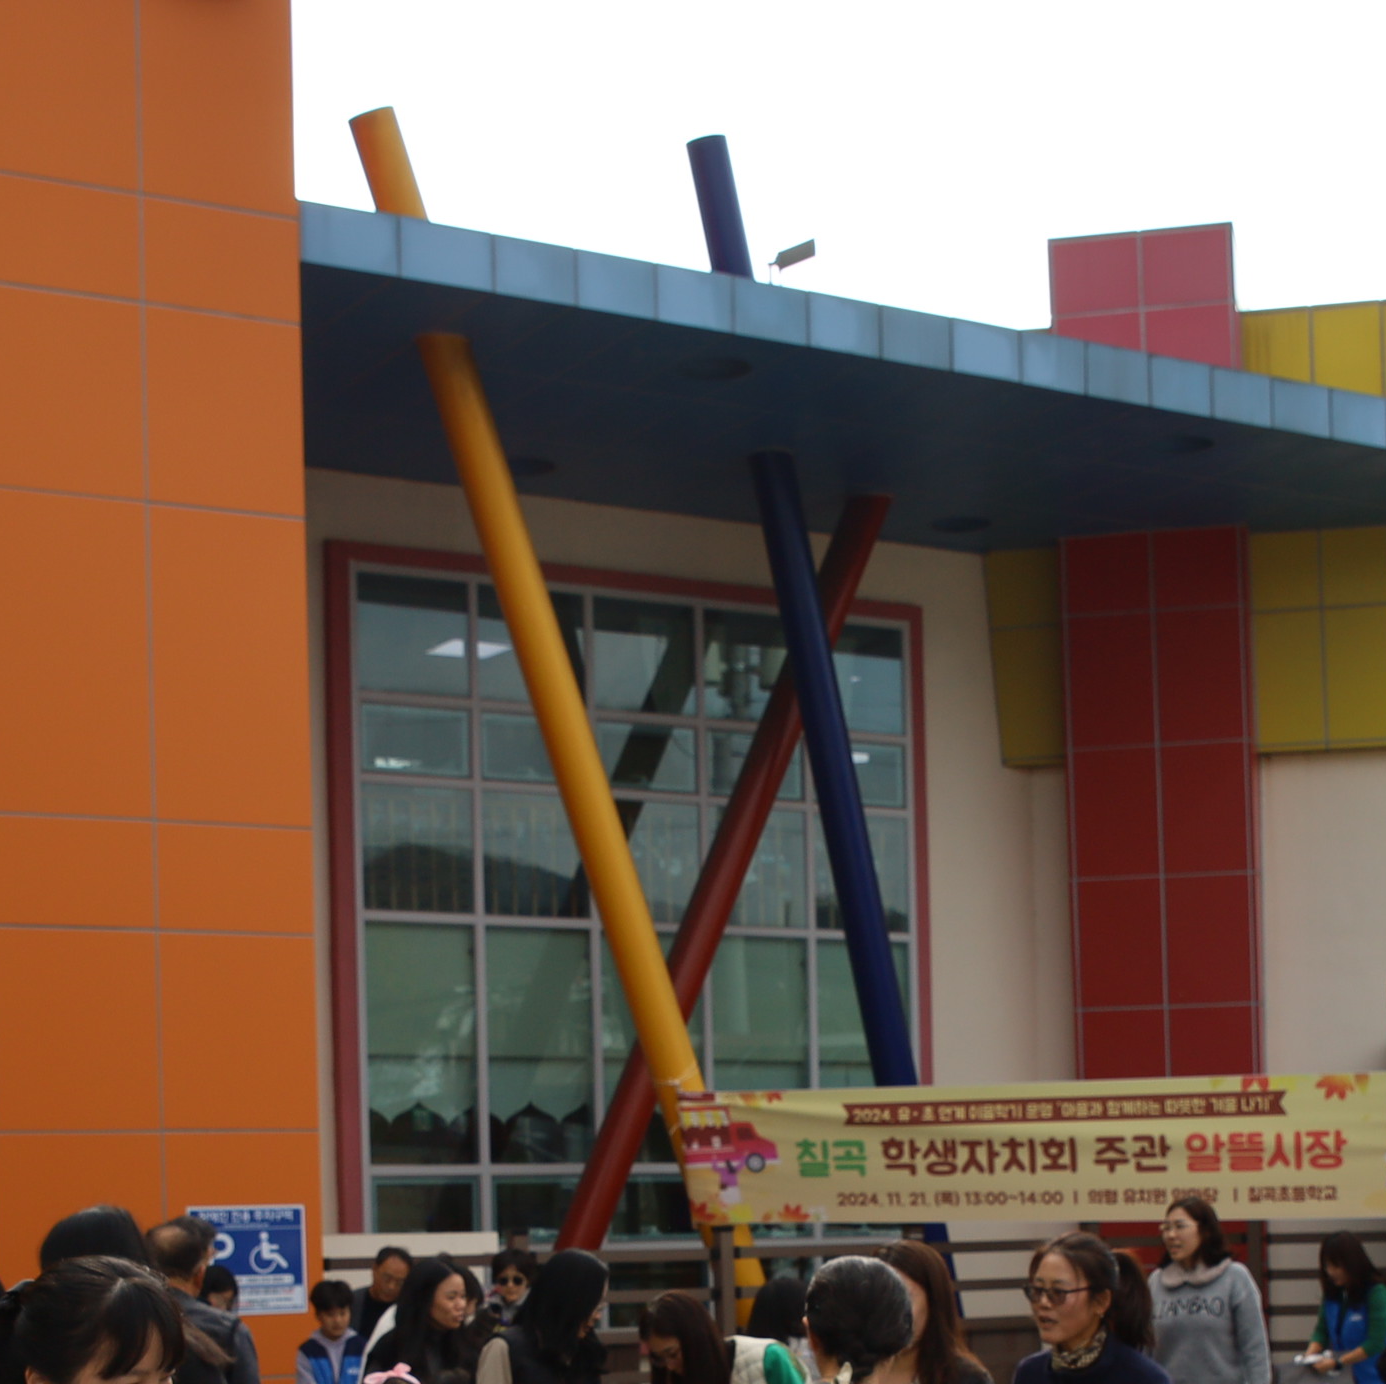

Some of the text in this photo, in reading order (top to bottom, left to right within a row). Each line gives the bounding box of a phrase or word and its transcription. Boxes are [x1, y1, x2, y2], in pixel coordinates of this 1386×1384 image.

[795, 1130, 1347, 1177] 칠곡 학생자치회 주관 알뜰시장
